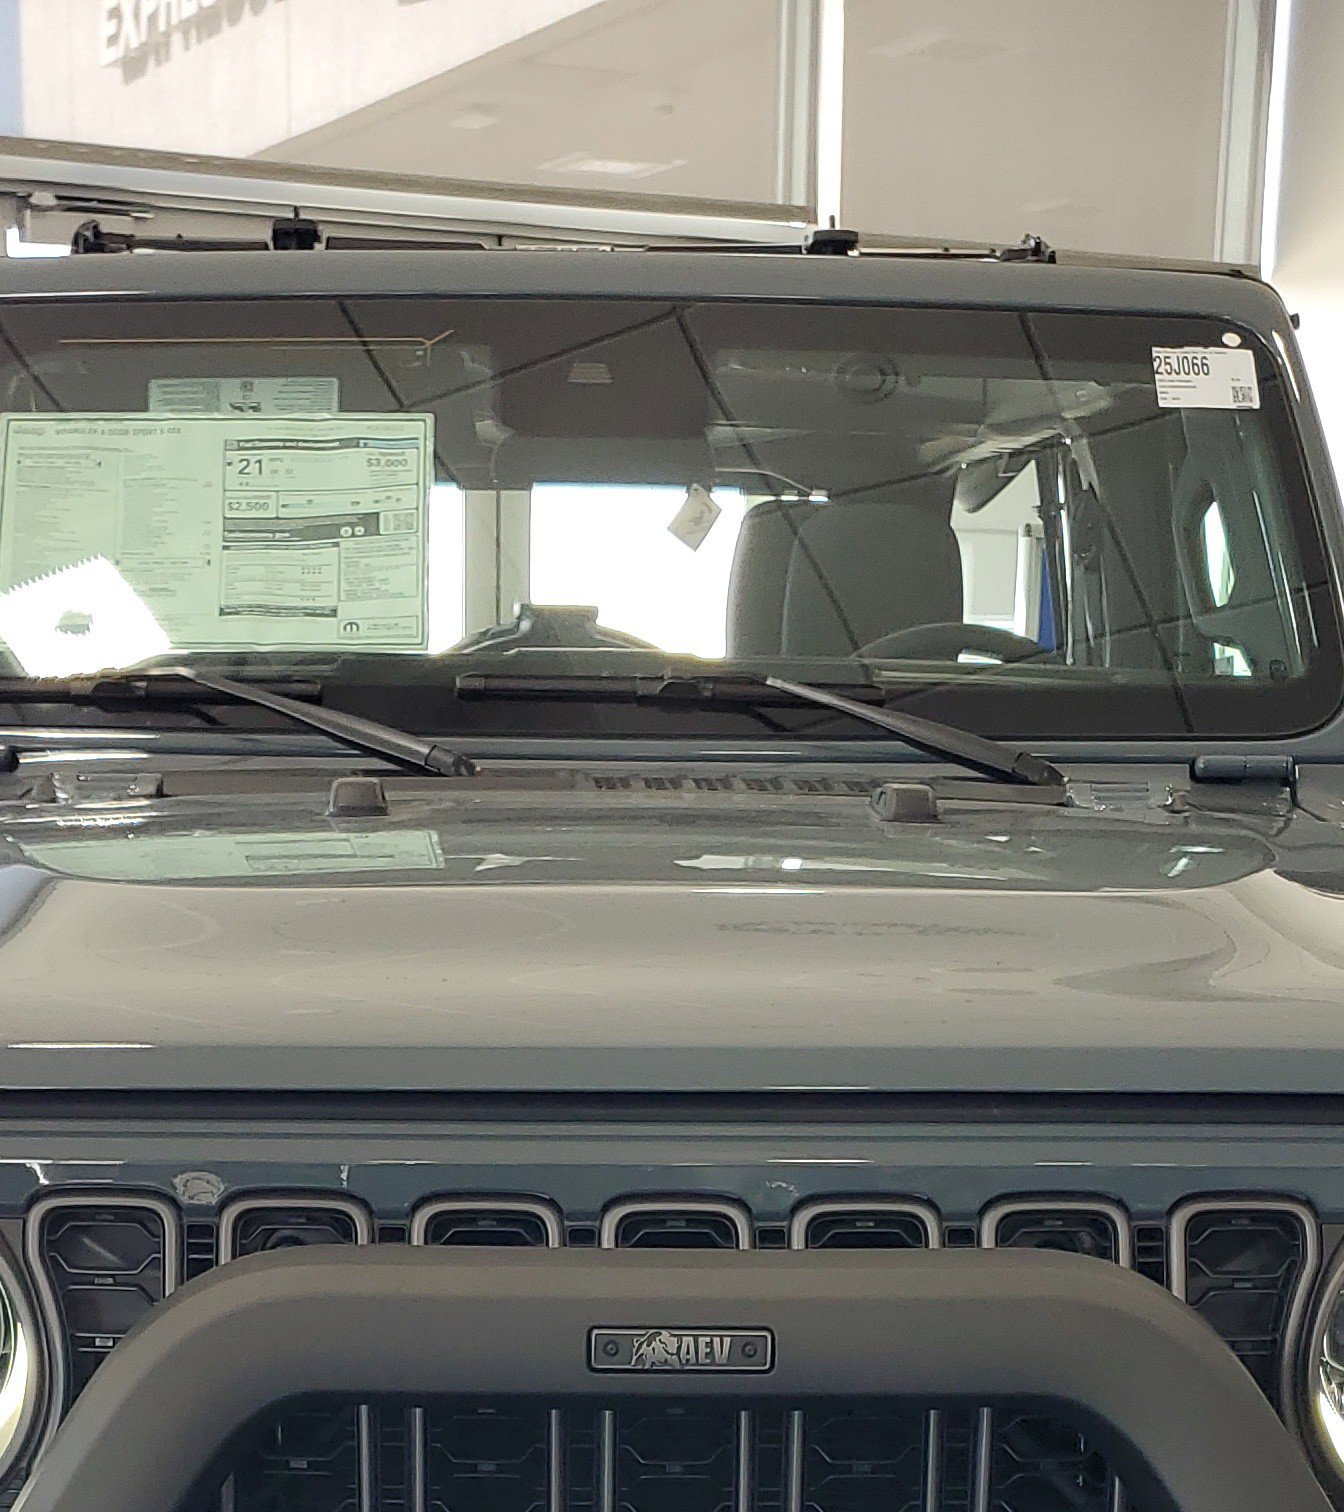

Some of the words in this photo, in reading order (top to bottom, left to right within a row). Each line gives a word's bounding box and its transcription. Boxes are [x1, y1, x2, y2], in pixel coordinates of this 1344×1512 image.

[1154, 355, 1210, 377] 25J066
[238, 458, 263, 476] 21
[680, 1336, 732, 1365] AEV
